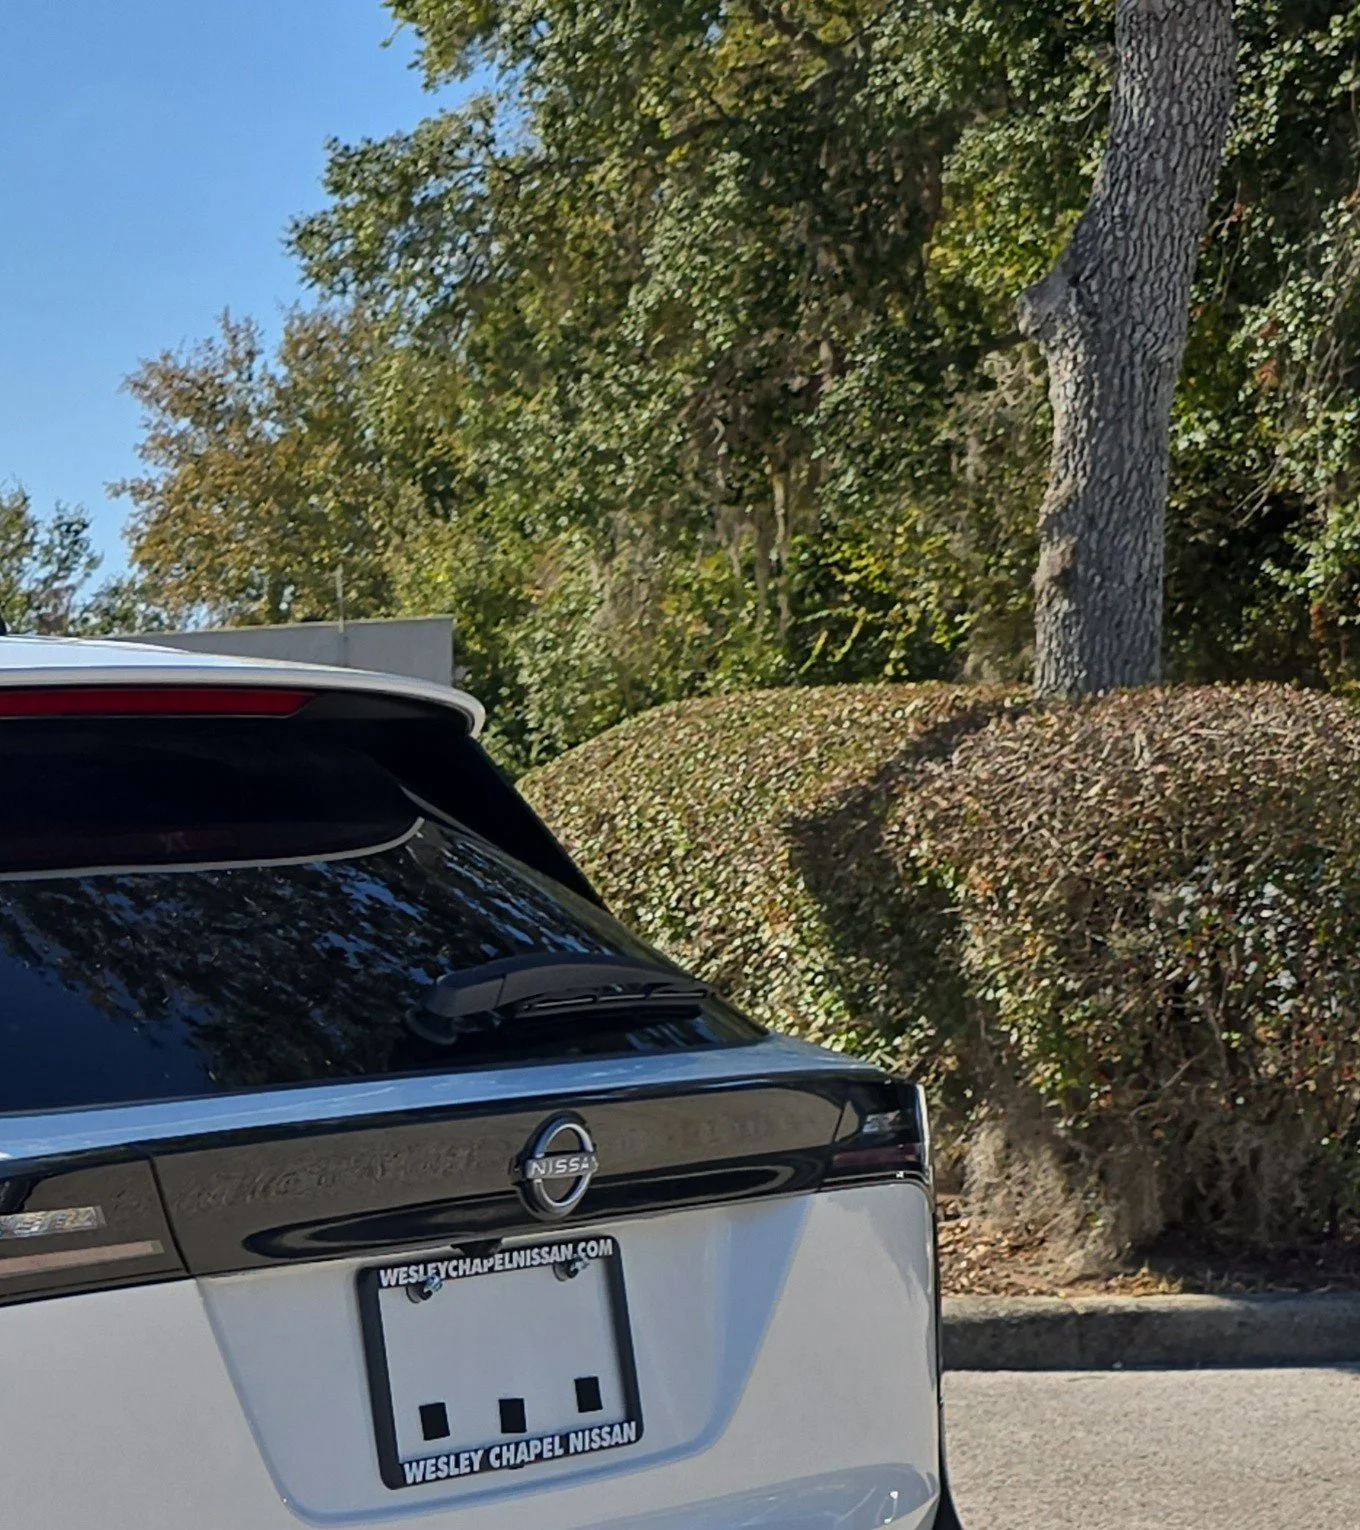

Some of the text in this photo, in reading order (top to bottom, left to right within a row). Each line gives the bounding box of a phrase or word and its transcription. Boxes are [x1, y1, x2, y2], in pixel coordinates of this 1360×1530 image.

[403, 1421, 637, 1485] WESLEY CHAPEL NISSAN
